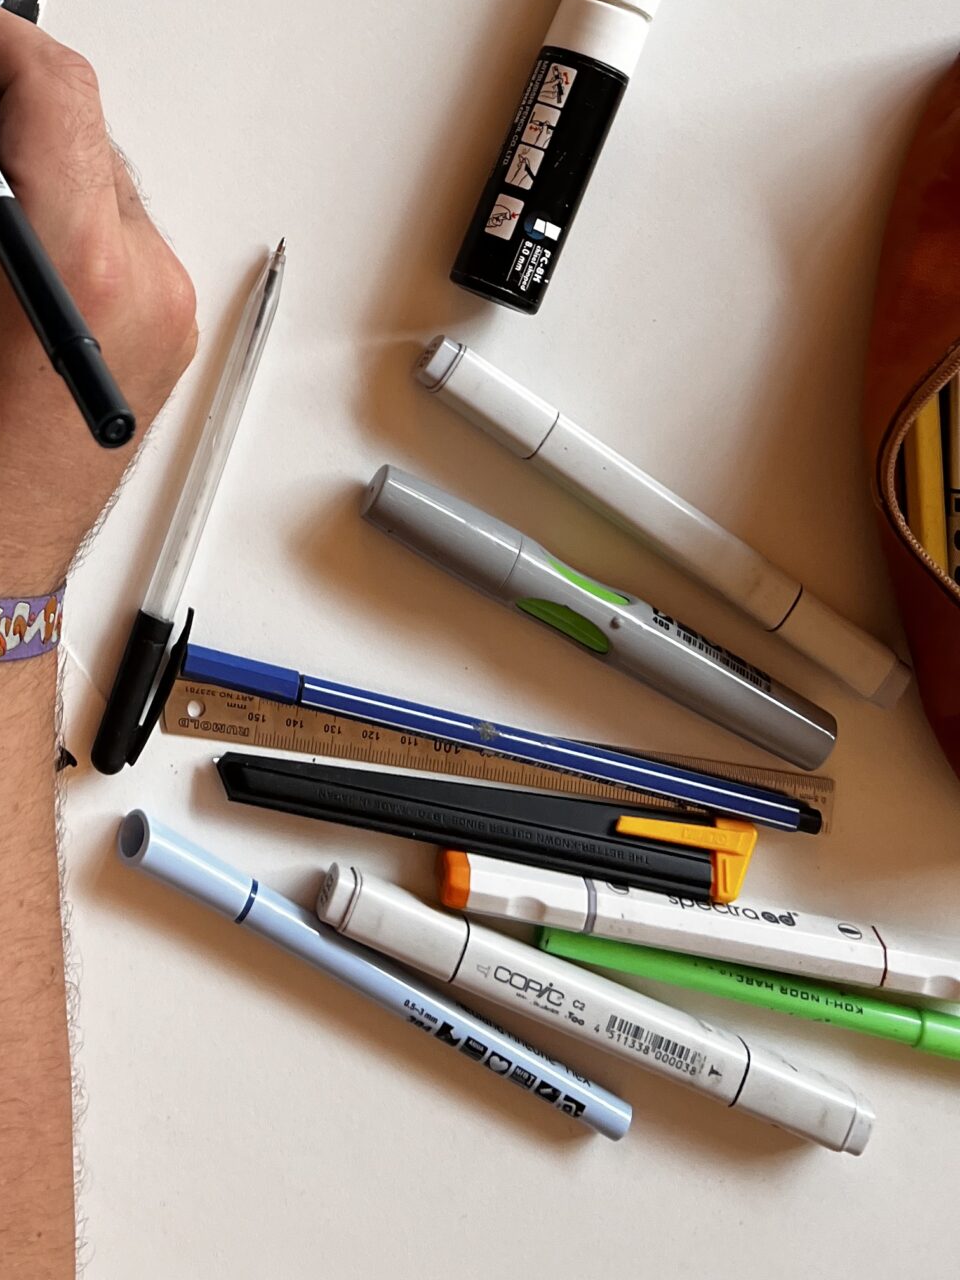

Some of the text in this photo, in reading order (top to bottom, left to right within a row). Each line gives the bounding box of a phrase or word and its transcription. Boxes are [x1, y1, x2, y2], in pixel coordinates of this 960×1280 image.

[514, 240, 533, 272] 8.0 mm
[532, 249, 552, 283] PC-8K
[518, 264, 535, 291] shaped
[226, 701, 247, 711] mm
[247, 712, 267, 723] 150
[285, 718, 305, 729] 140
[177, 716, 250, 739] RUMOLD
[323, 723, 343, 736] 130
[361, 729, 381, 742] 120
[399, 735, 419, 747] 110
[778, 985, 821, 1003] NOOR
[571, 999, 587, 1012] C2
[824, 999, 865, 1015] KOH-I
[423, 1012, 439, 1024] mm
